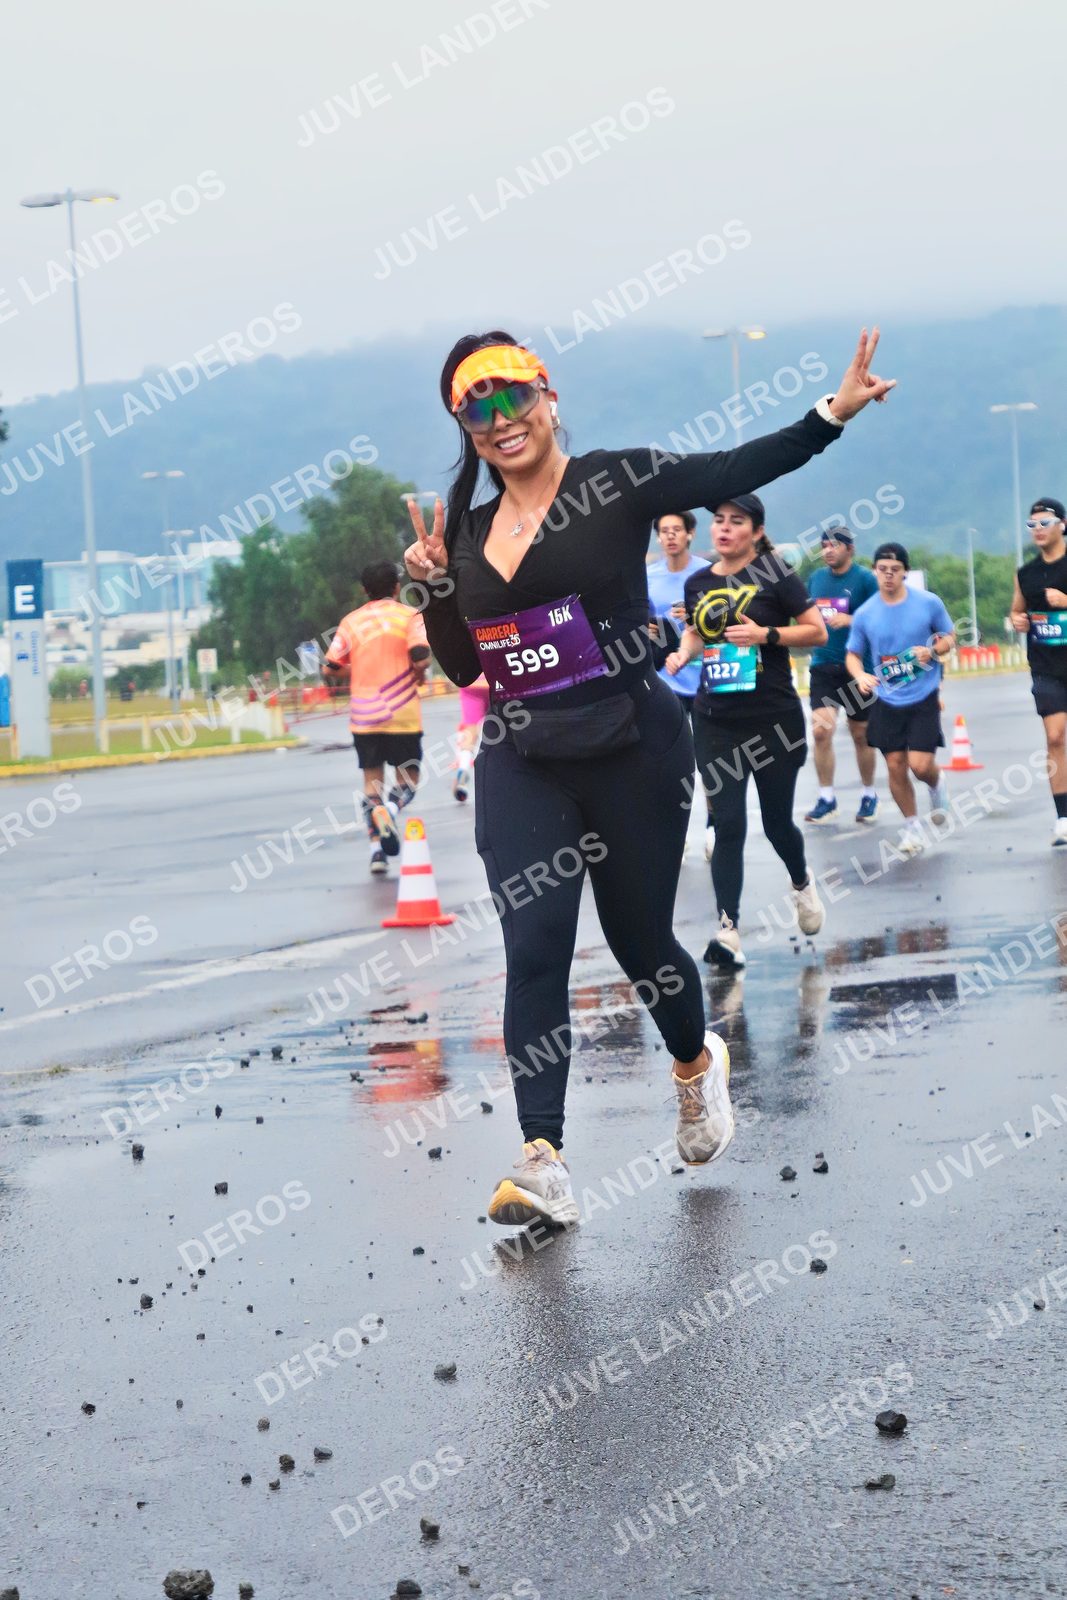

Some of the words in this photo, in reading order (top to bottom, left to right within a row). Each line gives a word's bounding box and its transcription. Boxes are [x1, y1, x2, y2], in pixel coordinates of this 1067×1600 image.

[14, 584, 36, 614] E
[475, 622, 518, 641] CARRERA
[505, 643, 560, 676] 599
[706, 662, 741, 680] 1227
